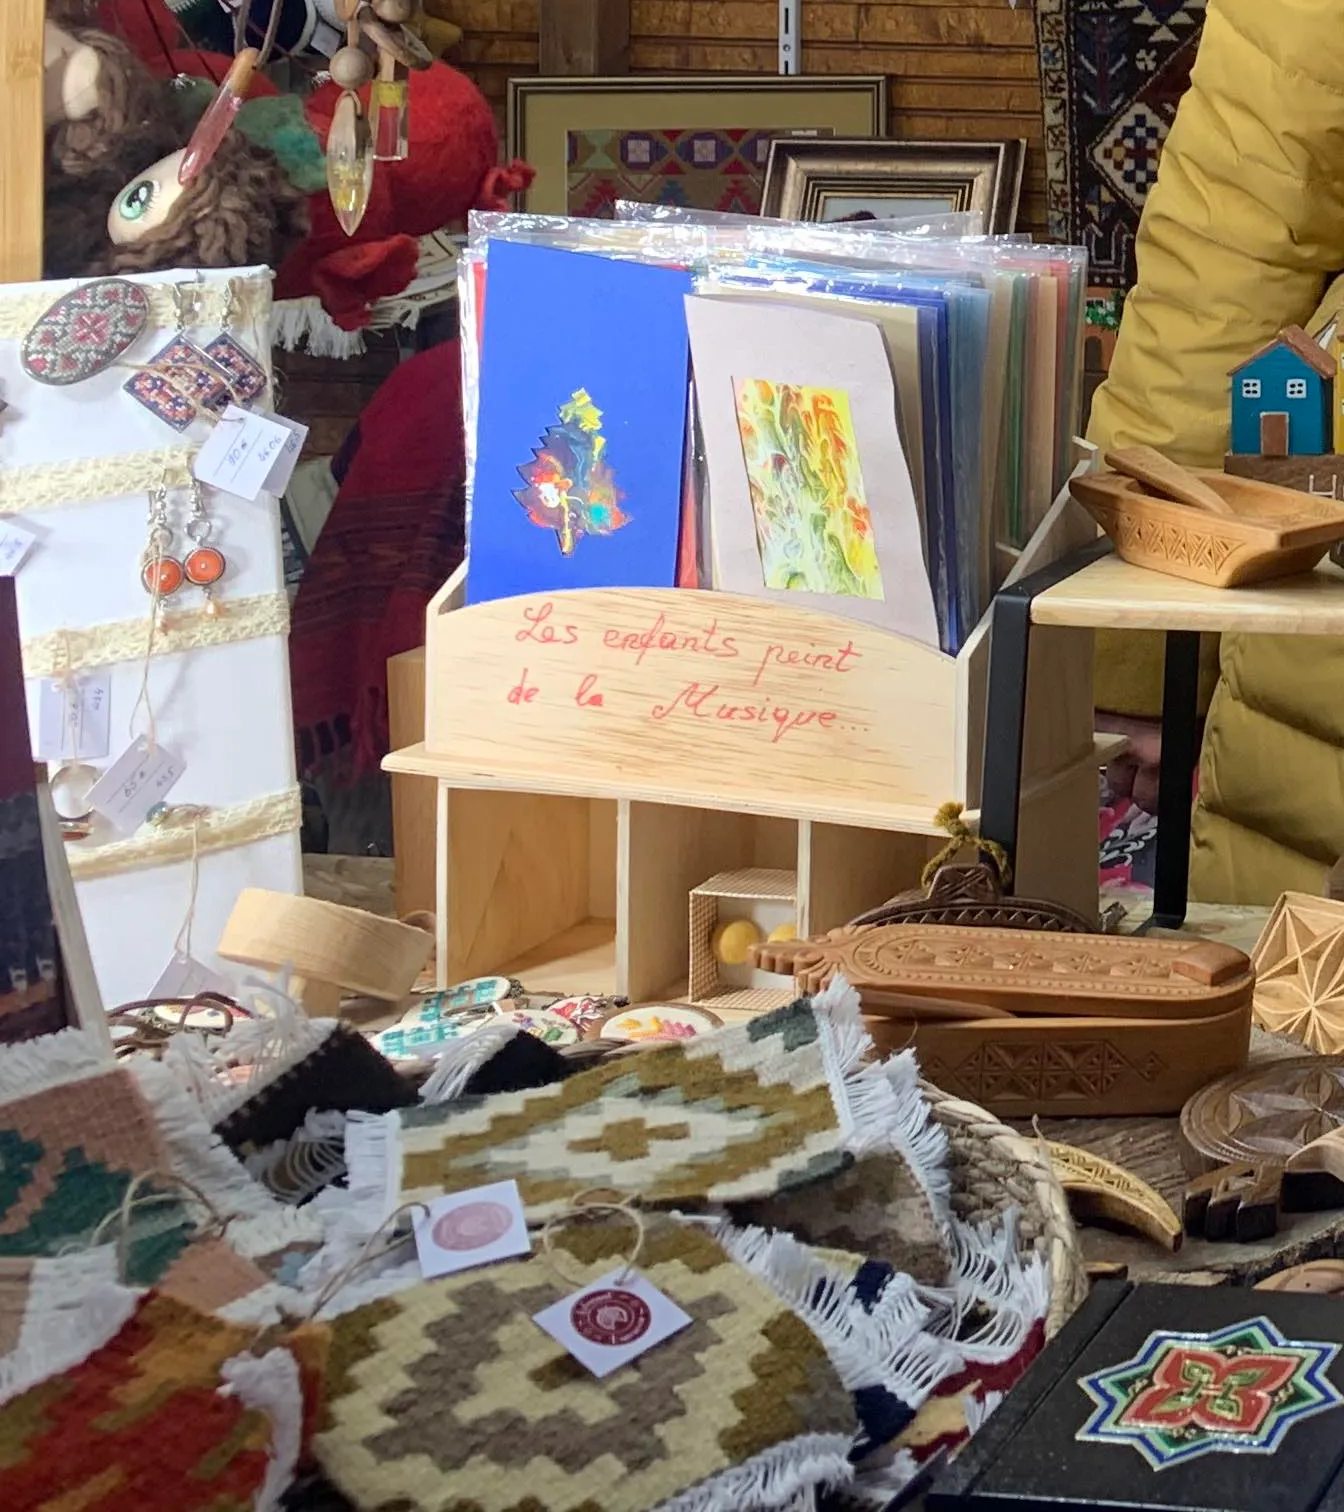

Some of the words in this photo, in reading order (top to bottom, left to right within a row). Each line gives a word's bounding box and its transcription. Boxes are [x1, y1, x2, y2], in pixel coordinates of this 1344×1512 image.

[515, 602, 579, 644] Les
[602, 615, 740, 666] enfants
[761, 639, 864, 686] peint
[507, 668, 540, 706] de
[575, 674, 605, 709] la
